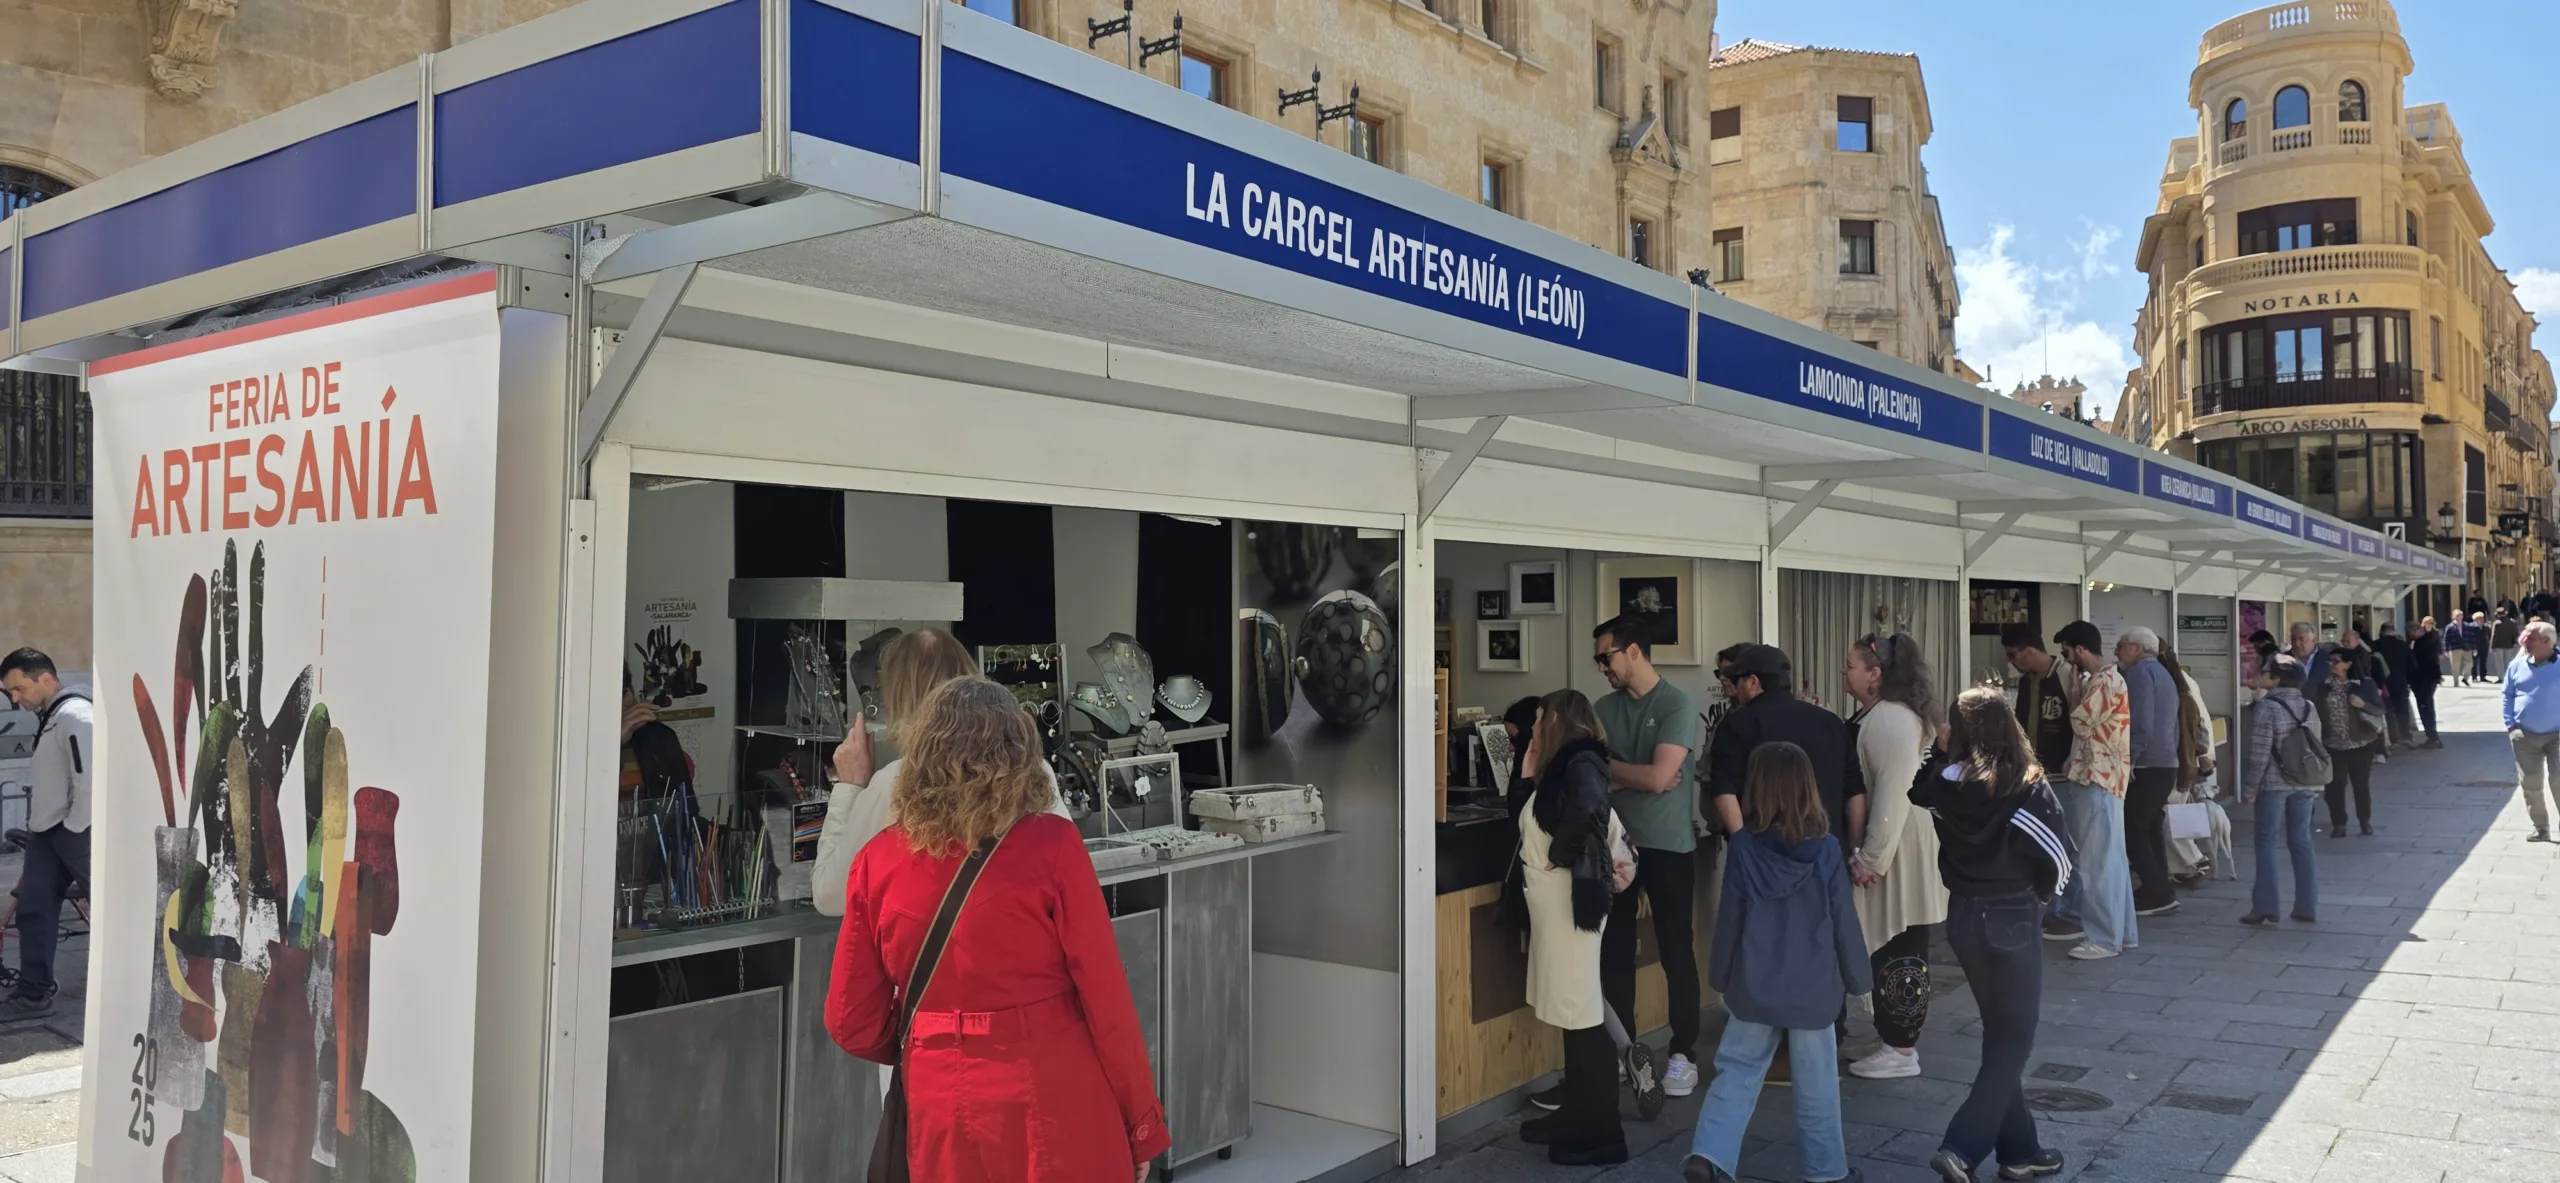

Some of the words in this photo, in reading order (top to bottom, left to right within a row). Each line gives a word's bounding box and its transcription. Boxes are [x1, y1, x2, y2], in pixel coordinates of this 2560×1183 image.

[1186, 162, 1230, 228] LA
[1242, 182, 1360, 269] CARCEL
[1368, 227, 1510, 312] ARTESANÍA
[1517, 273, 1585, 340] (LEÓN)
[2244, 289, 2360, 313] NOTARÍA
[209, 372, 290, 432] FERIA
[301, 361, 342, 418] DE
[1800, 361, 1865, 410] LAMOONDA
[1868, 383, 1922, 431] (PALENCIA)
[2240, 420, 2285, 436] ARCO
[2290, 416, 2368, 432] ASESORÍA
[130, 384, 438, 539] ARTESANÍA
[2031, 433, 2044, 458] LUZ
[2044, 437, 2054, 462] DE
[2054, 440, 2070, 467] VELA
[2071, 446, 2110, 482] (VALLADOLID)
[644, 600, 697, 612] ARTESANÍA
[132, 1033, 158, 1091] 20
[128, 1087, 155, 1147] 25
